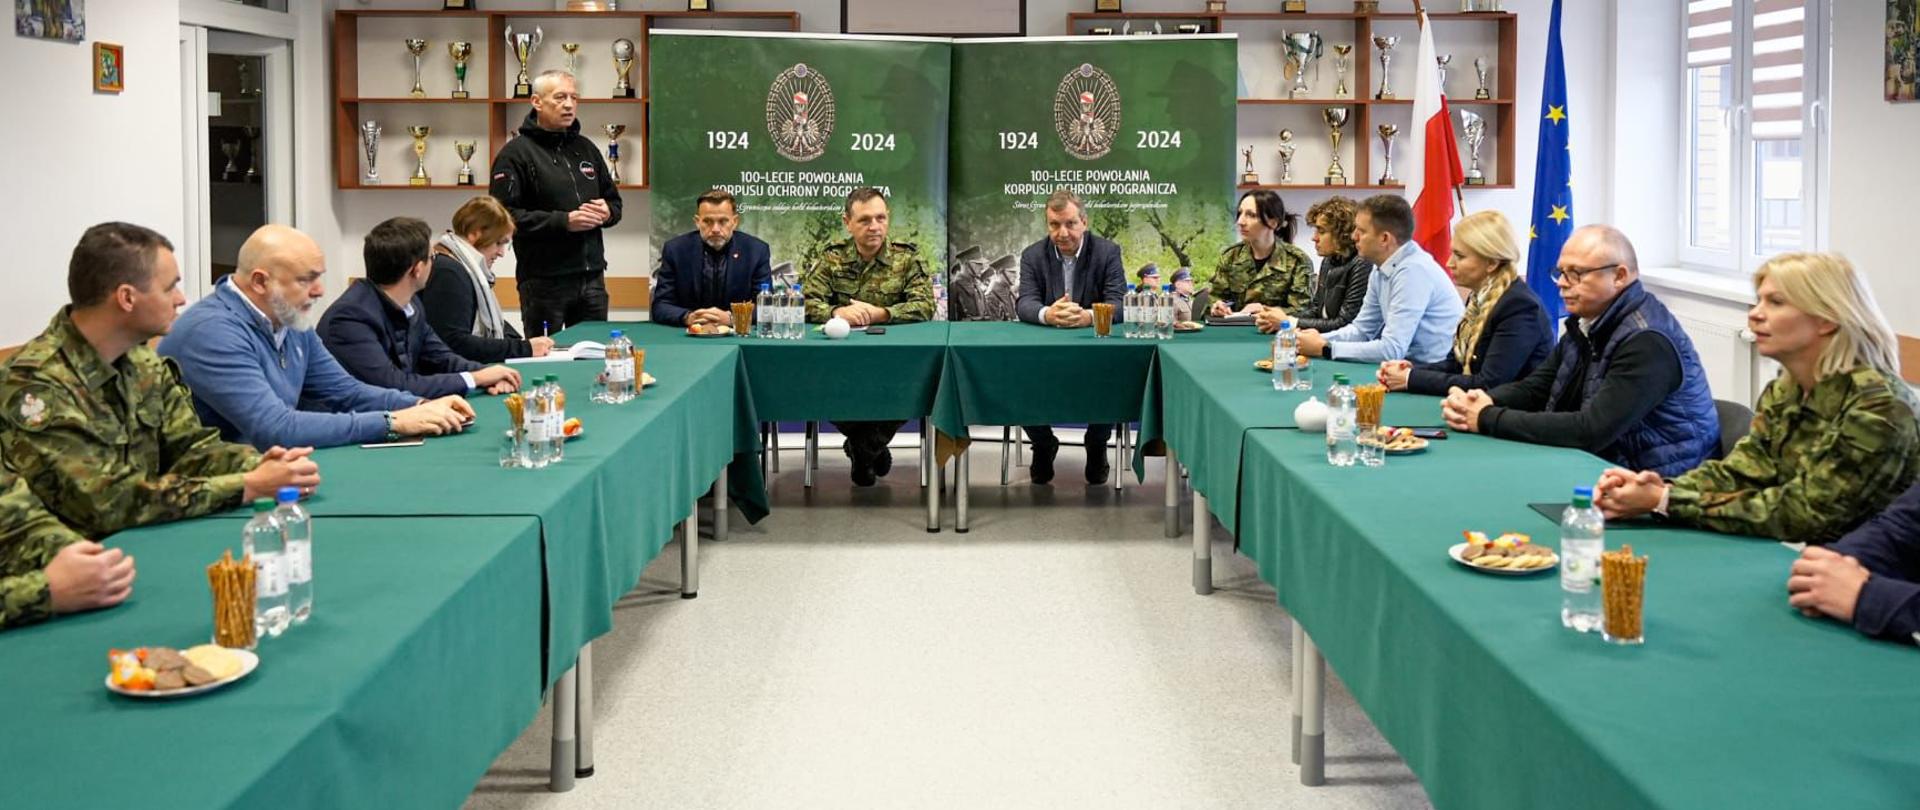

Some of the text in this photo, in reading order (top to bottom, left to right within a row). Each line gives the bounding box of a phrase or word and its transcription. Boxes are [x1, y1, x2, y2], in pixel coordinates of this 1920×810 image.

[707, 131, 750, 149] 1924
[851, 133, 896, 151] 2024
[999, 132, 1038, 149] 1924
[1136, 130, 1182, 148] 2024
[740, 171, 864, 184] 100-LECIE POWOŁANIA
[1030, 170, 1150, 182] 100-LECIE POWOŁANIA
[767, 185, 819, 197] OCHRONY
[1004, 183, 1052, 195] KORPUSU
[1110, 183, 1177, 195] POGRANICZA
